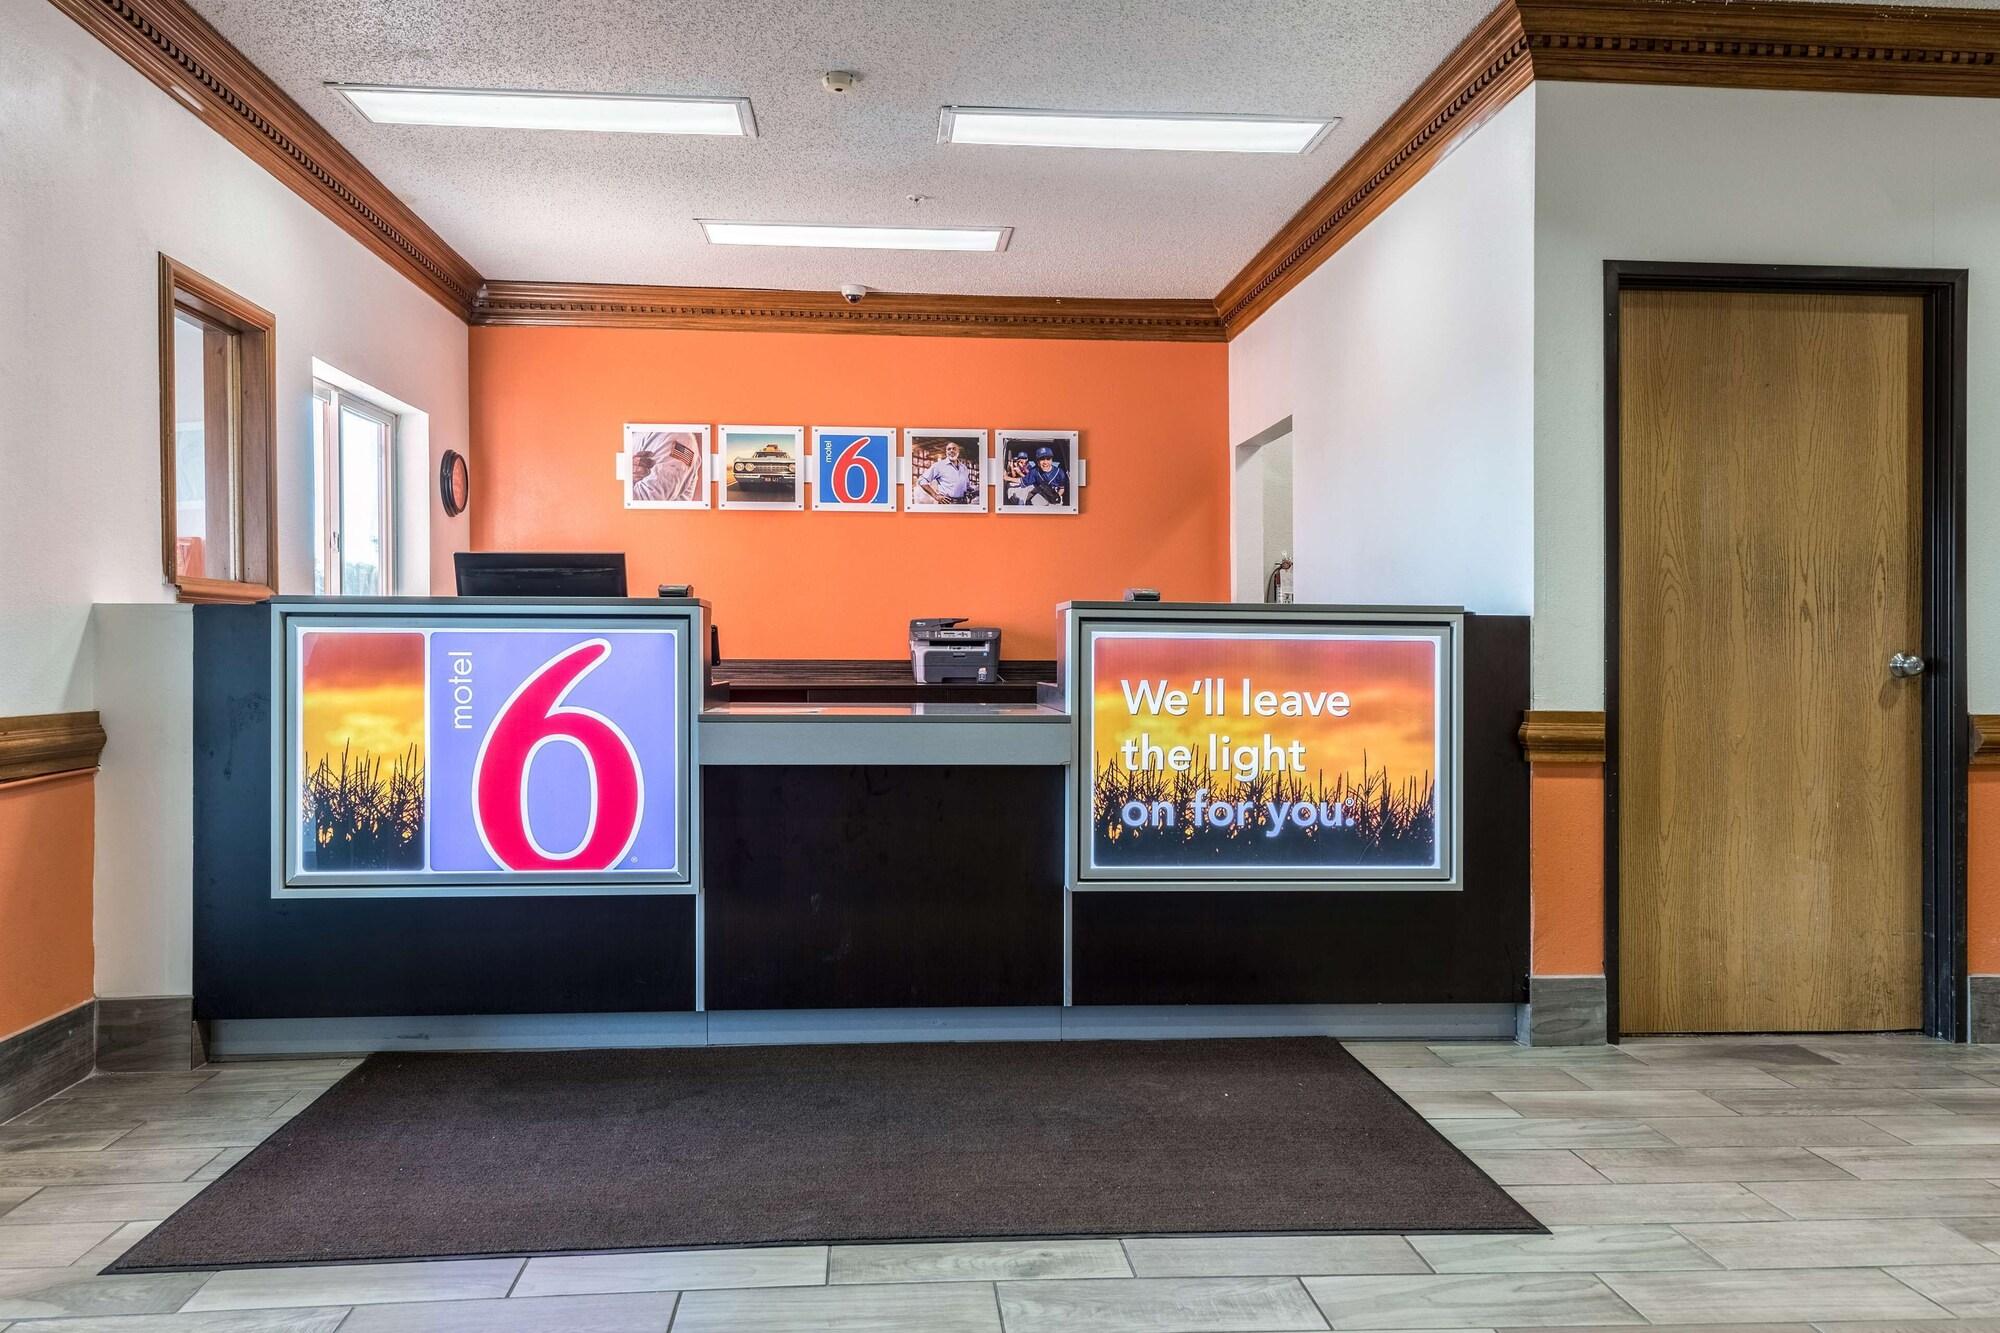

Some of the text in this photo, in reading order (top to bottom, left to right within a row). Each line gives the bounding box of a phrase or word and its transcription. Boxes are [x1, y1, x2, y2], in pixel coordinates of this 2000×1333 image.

[824, 440, 832, 463] motel
[831, 436, 880, 504] 6
[448, 651, 473, 730] motel
[1121, 678, 1352, 717] We'll leave
[471, 637, 645, 871] 6
[1121, 733, 1306, 783] the light
[1121, 800, 1174, 827] on
[1192, 789, 1253, 827] for
